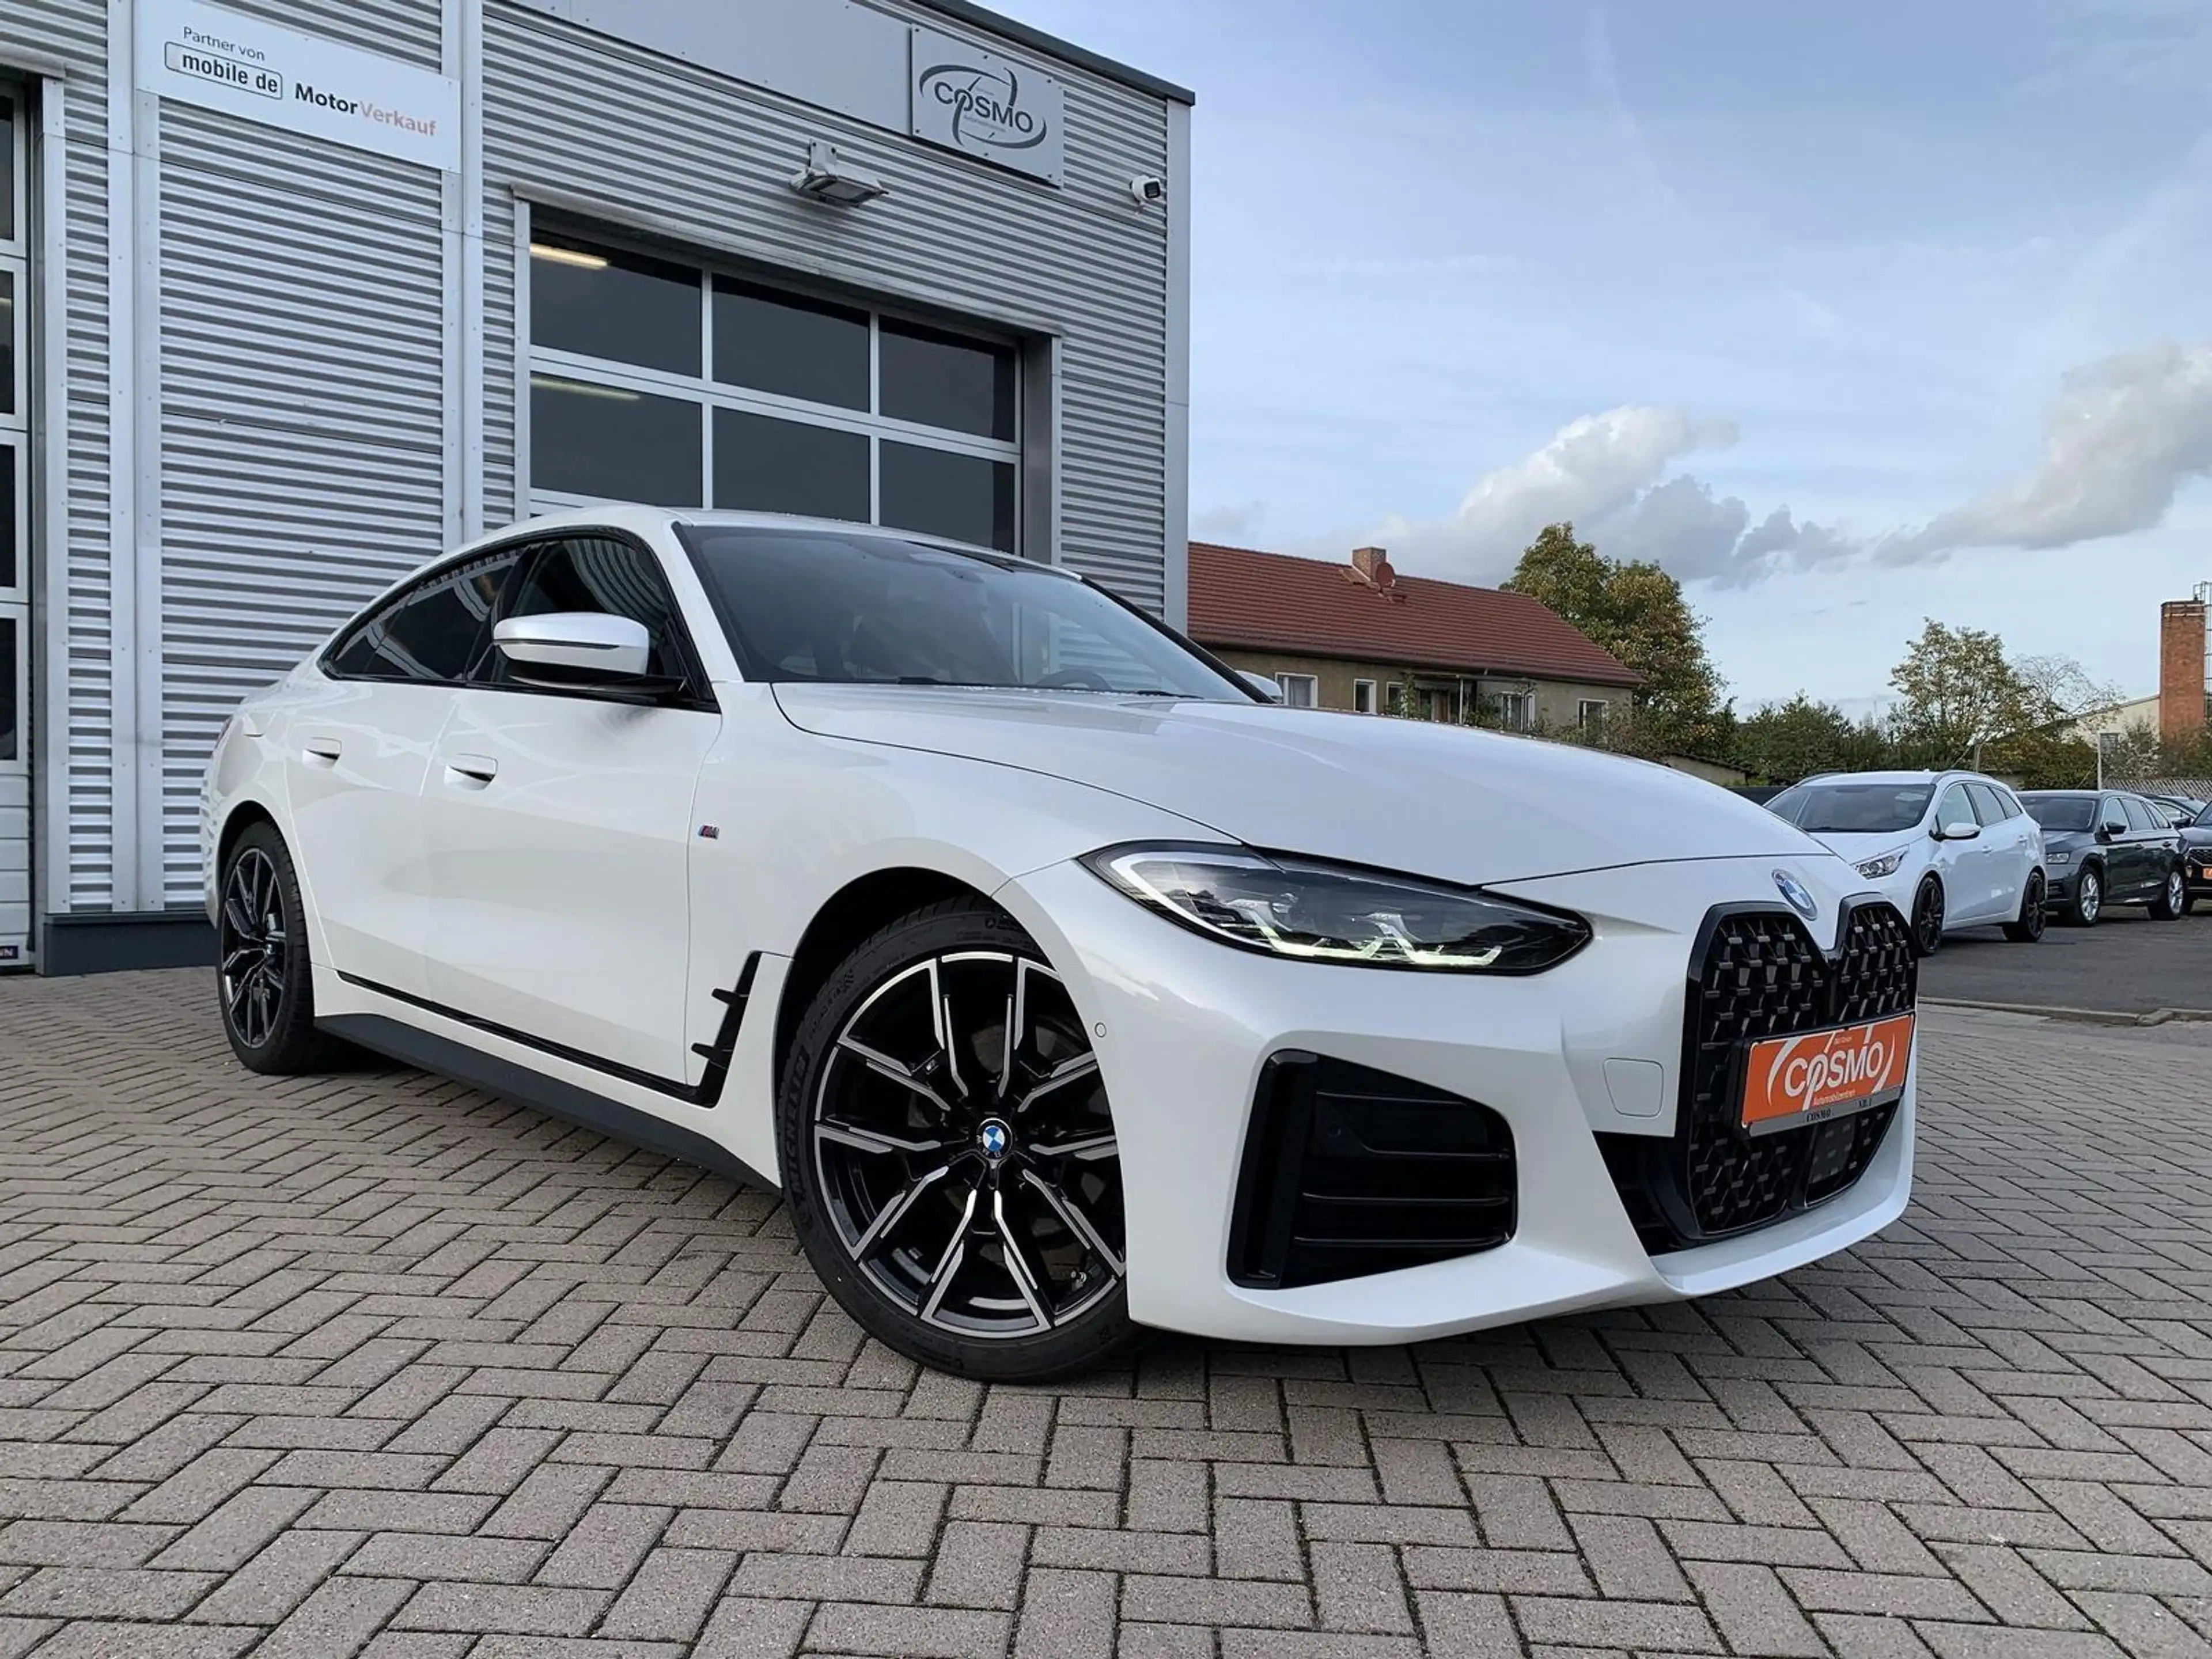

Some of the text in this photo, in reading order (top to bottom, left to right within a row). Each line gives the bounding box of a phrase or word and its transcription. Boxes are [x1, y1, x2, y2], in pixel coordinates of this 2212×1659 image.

[183, 26, 265, 61] Partner von
[934, 81, 1033, 133] COSMO
[1785, 1040, 1884, 1097] COSMO
